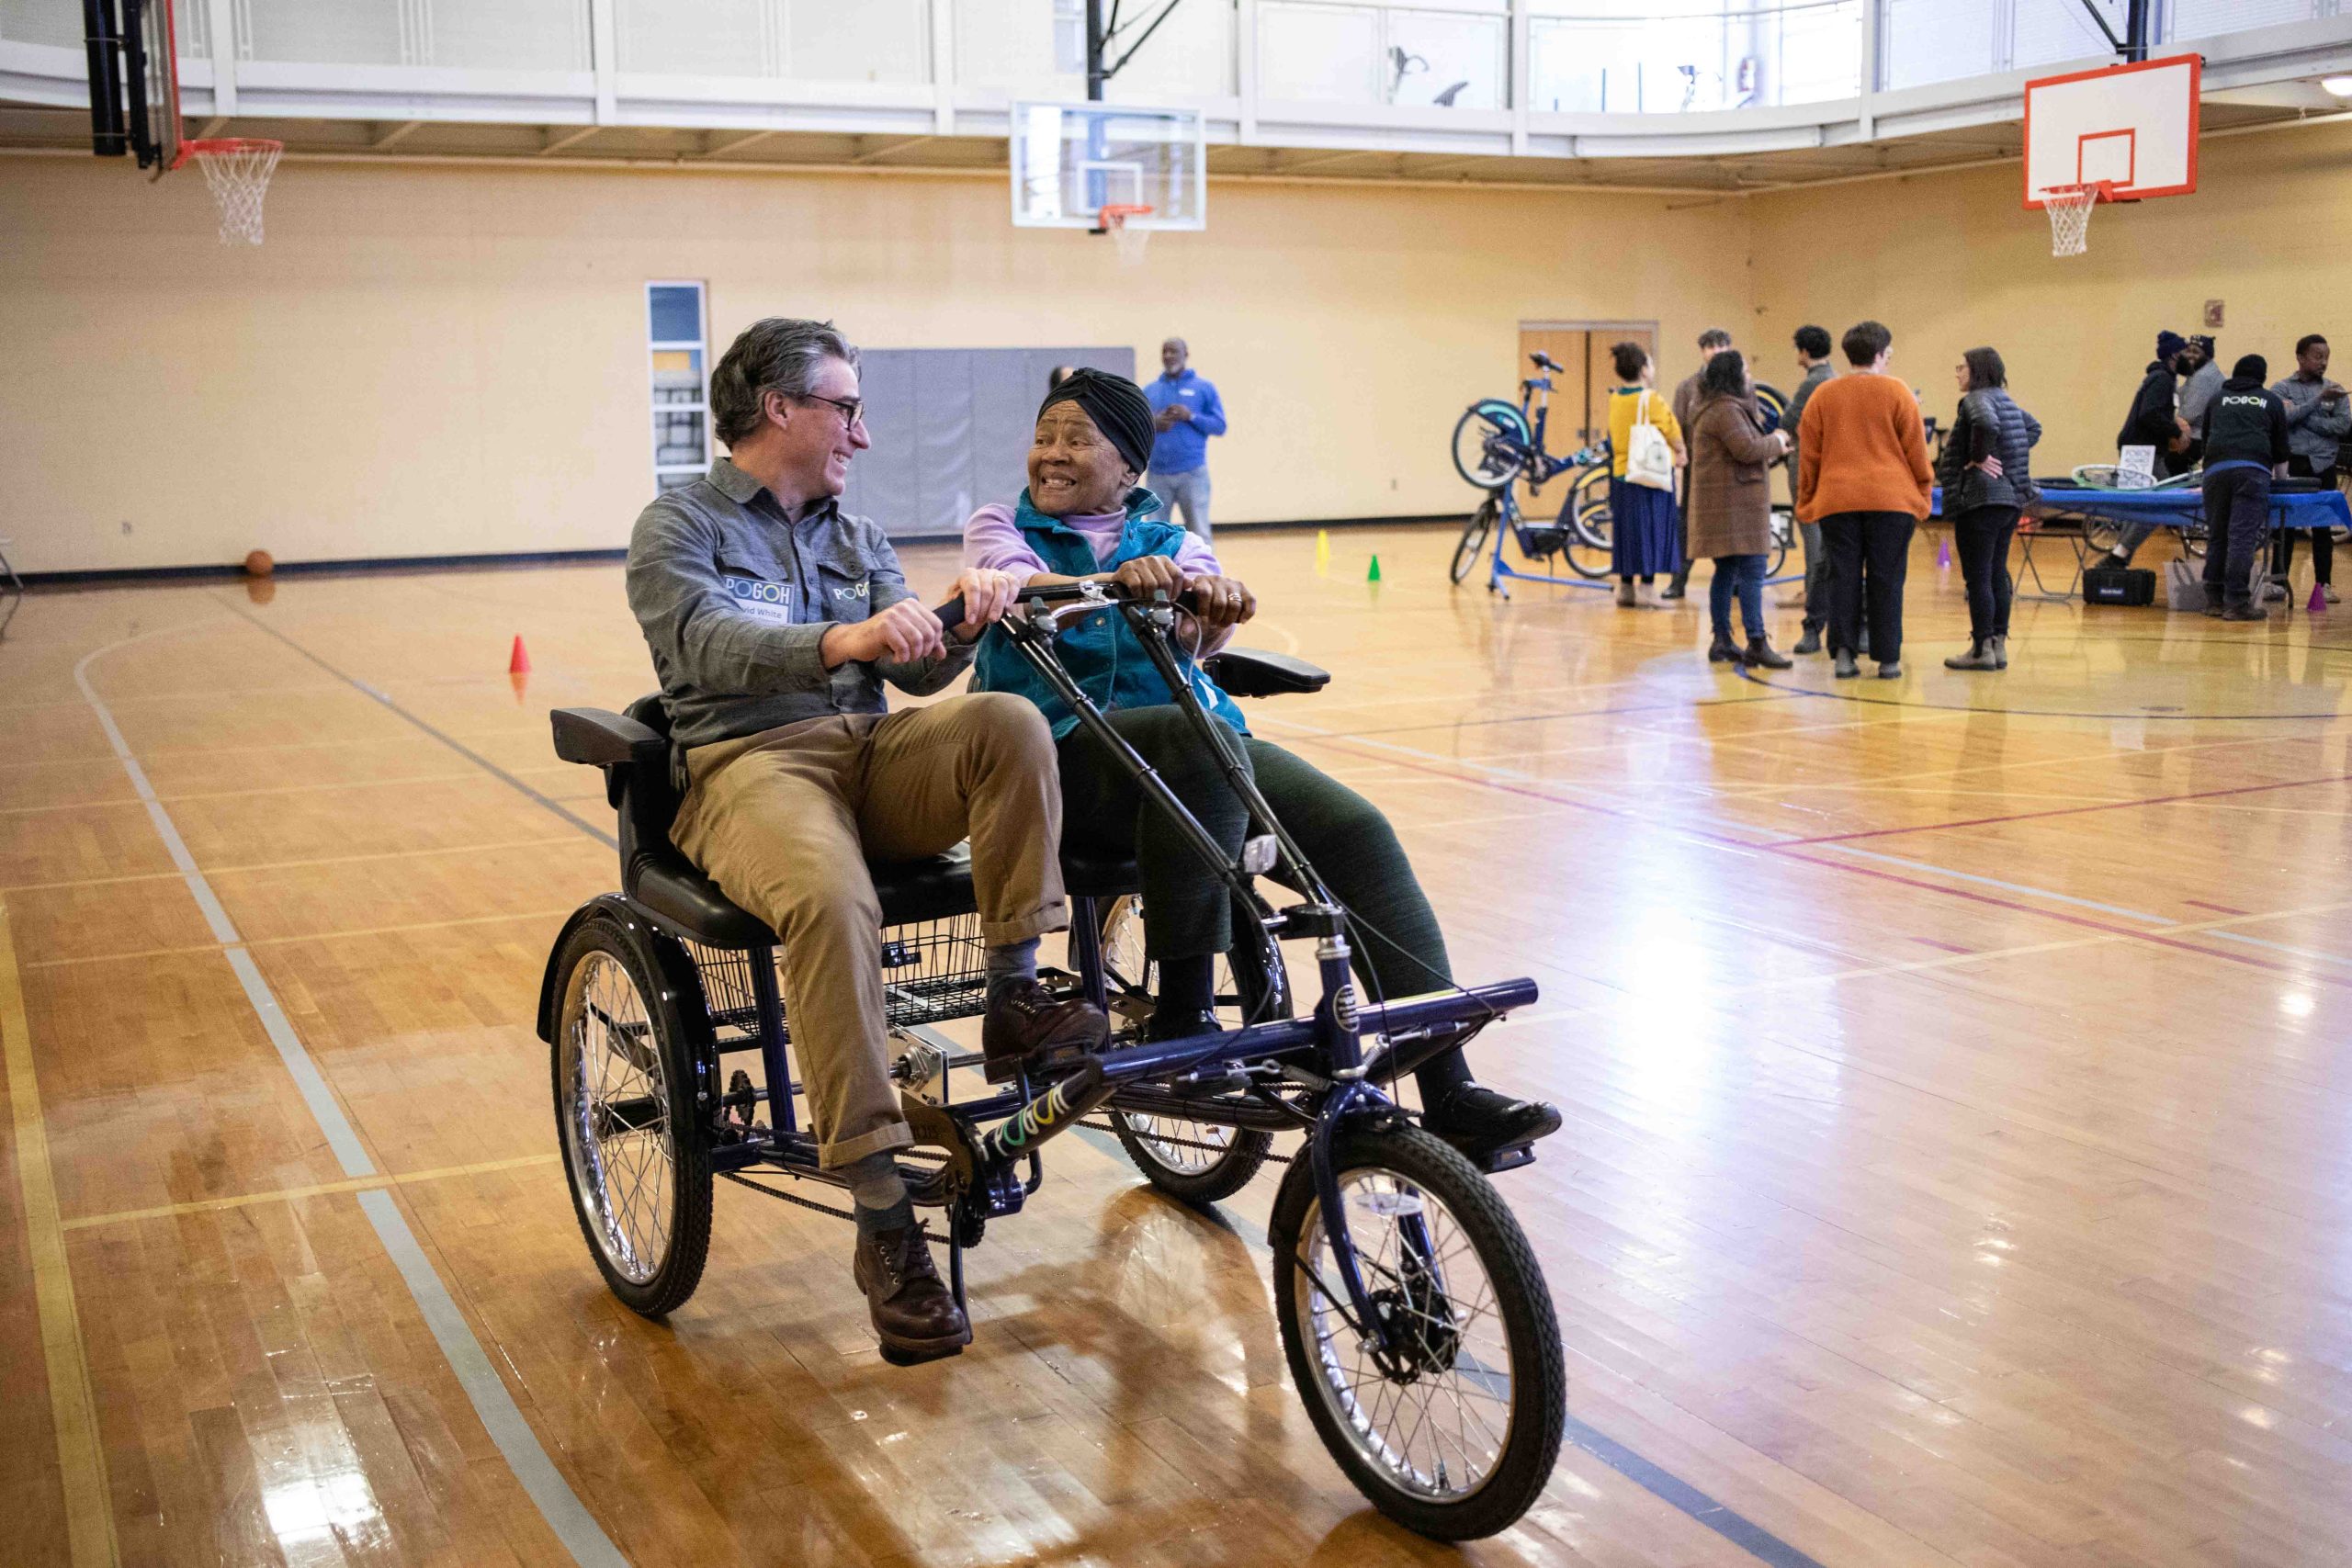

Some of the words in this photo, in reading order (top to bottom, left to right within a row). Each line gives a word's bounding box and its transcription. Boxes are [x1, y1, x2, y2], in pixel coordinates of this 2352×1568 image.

[2222, 396, 2267, 409] POGOH
[726, 578, 790, 604] POGOH
[833, 581, 870, 600] POG
